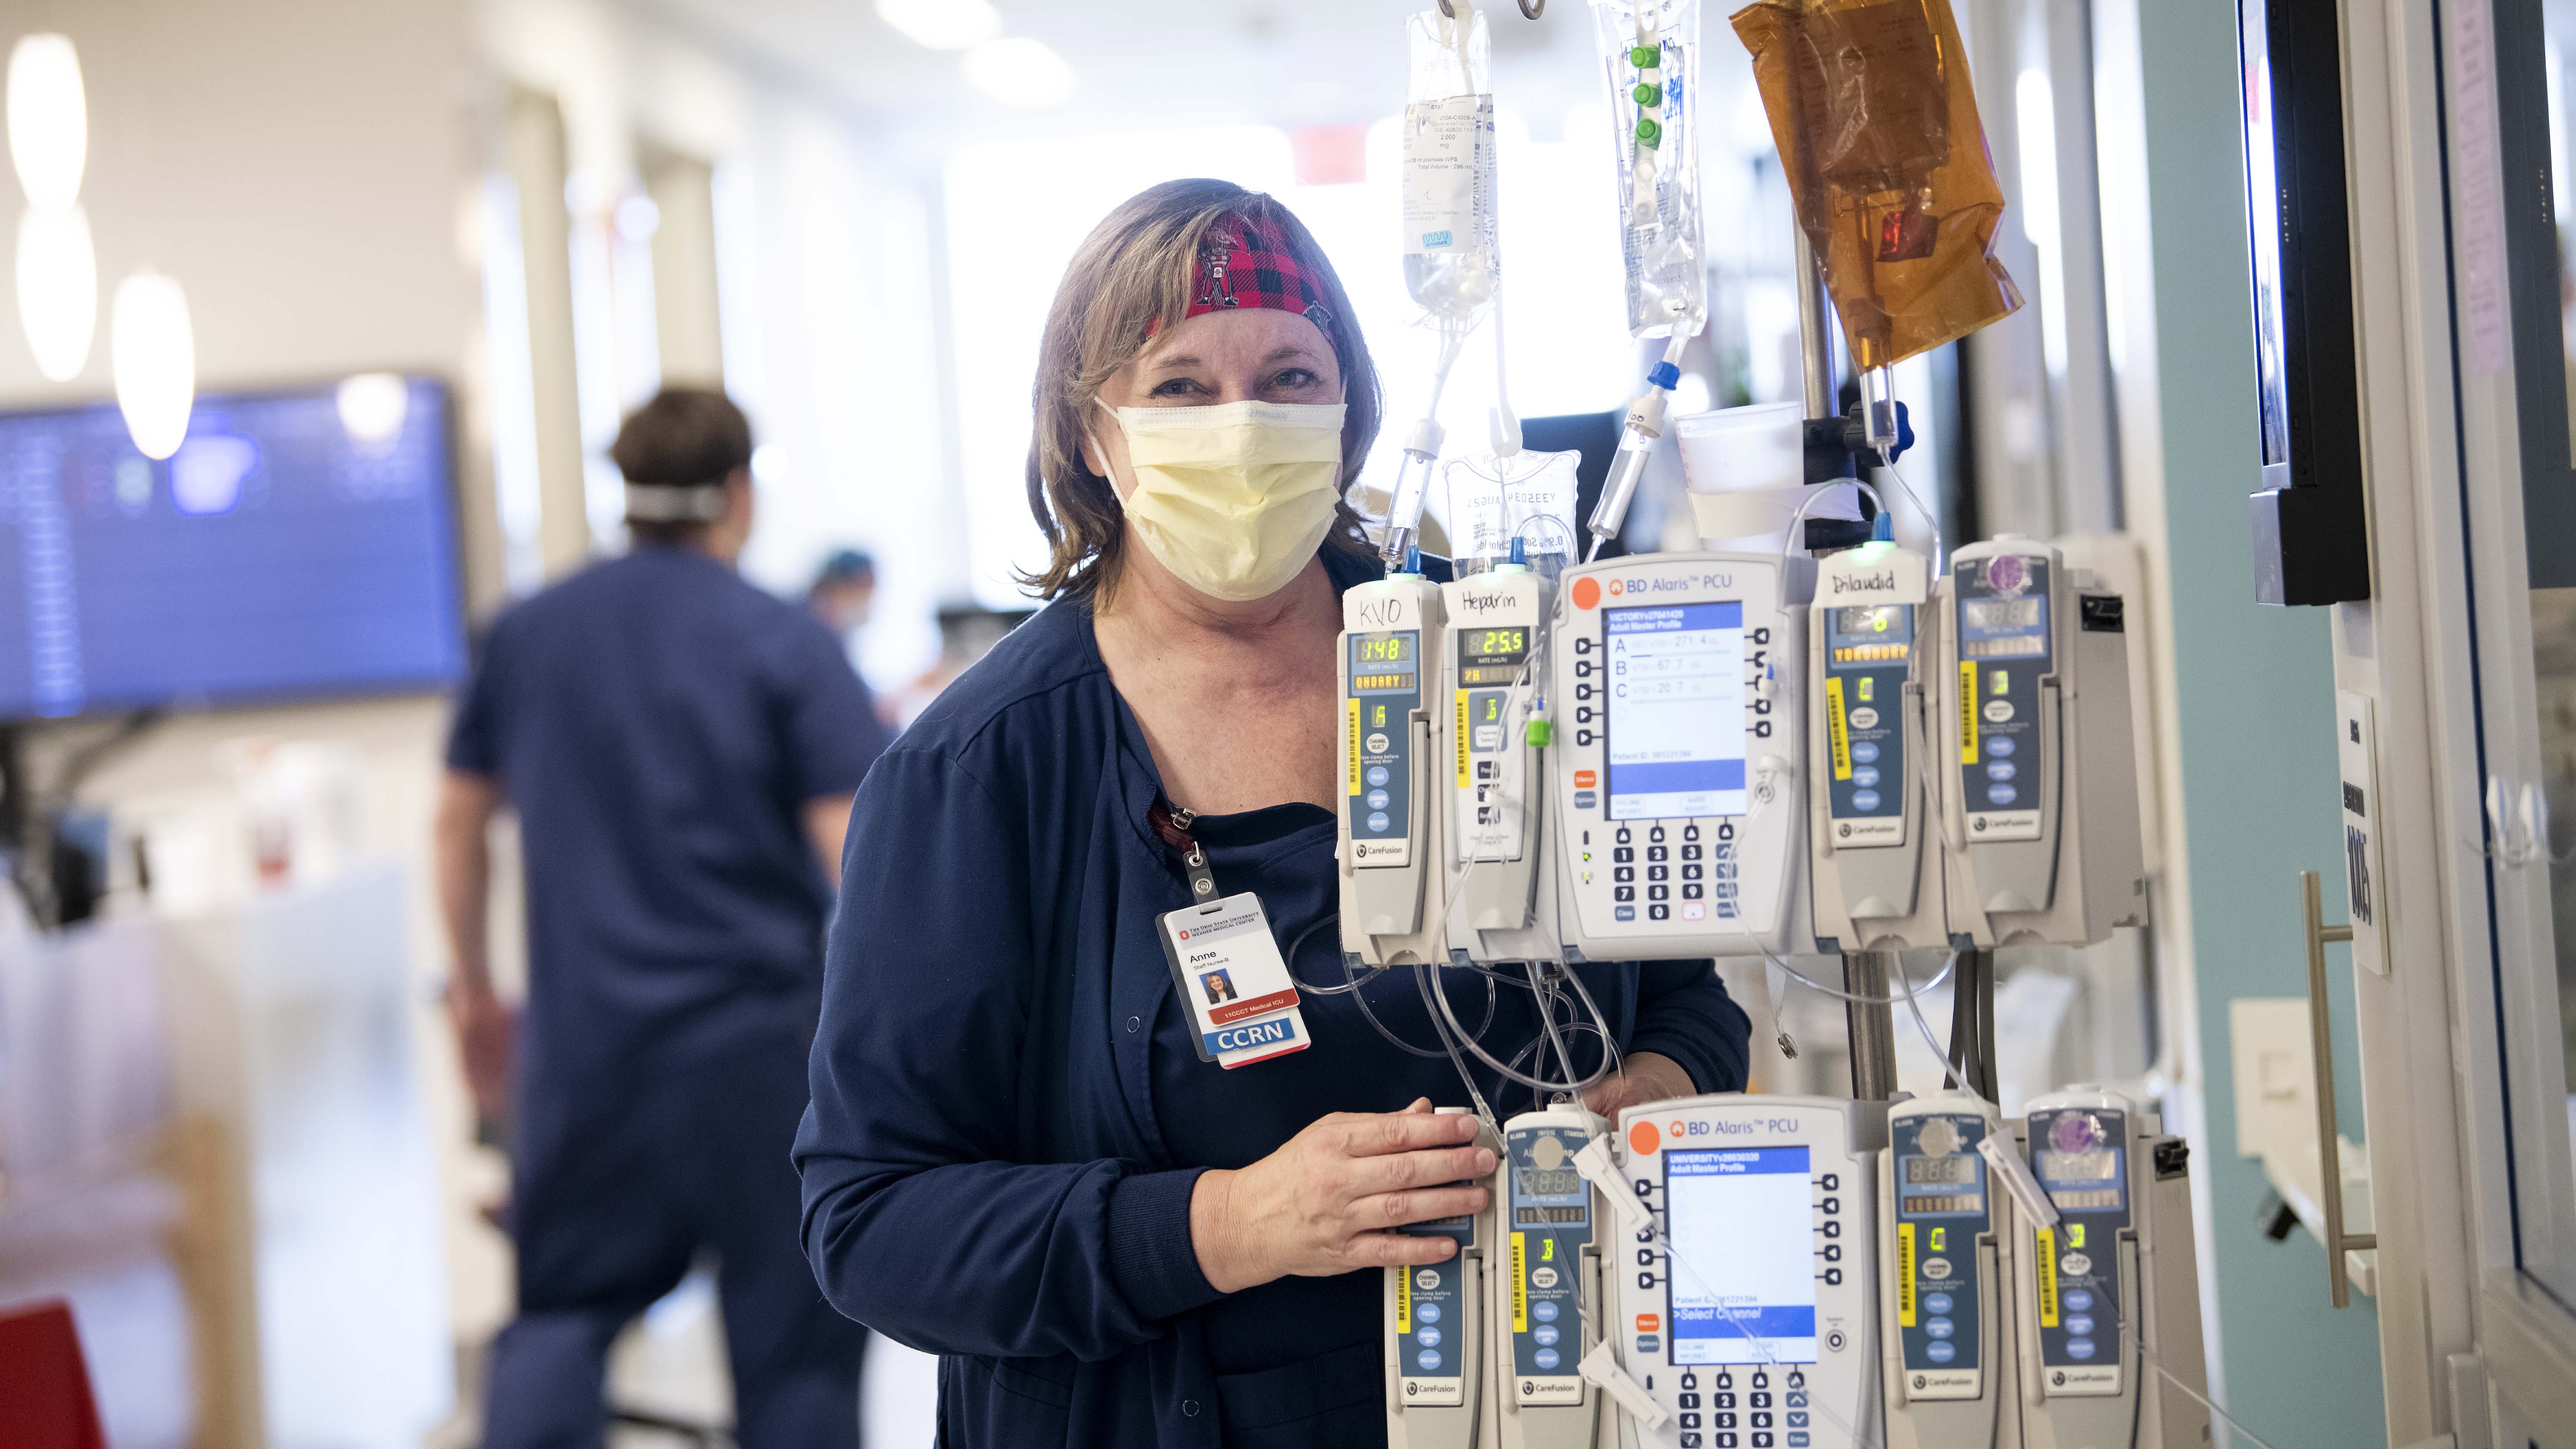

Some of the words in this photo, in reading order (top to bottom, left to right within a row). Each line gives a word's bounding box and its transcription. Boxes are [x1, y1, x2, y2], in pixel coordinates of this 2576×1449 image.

[1627, 580, 1647, 593] BD
[1703, 574, 1732, 588] PCU
[1832, 570, 1895, 593] Dilaudid
[1462, 591, 1516, 615] Heparin
[1360, 599, 1401, 626] KVO
[1366, 639, 1399, 660] 148
[1483, 631, 1522, 654] 25.5
[1615, 639, 1626, 652] A
[1616, 661, 1626, 675] B
[1356, 675, 1399, 689] ONDARY
[1859, 677, 1873, 701] C
[1616, 684, 1627, 698] C
[1376, 706, 1385, 724] A
[1621, 849, 1627, 861] 1
[1653, 848, 1662, 860] 2
[1688, 846, 1697, 859] 3
[1620, 868, 1629, 880] 4
[1655, 867, 1662, 879] 5
[1688, 866, 1697, 878] 6
[1620, 888, 1629, 900] 7
[1655, 887, 1663, 899] 8
[1688, 885, 1698, 898] 9
[1229, 912, 1259, 922] UNIVERSITY
[1654, 906, 1664, 919] 0
[1190, 951, 1216, 963] Anne
[1207, 958, 1229, 966] Nurse-B
[1225, 1008, 1248, 1018] 11CCCT
[1249, 1002, 1272, 1012] Medical
[1217, 1022, 1284, 1049] CCRN
[1689, 1122, 1709, 1135] BD
[1769, 1118, 1798, 1133] PCU
[1719, 1163, 1746, 1172] Profile
[1930, 1228, 1945, 1251] C
[1716, 1307, 1762, 1320] Cannel
[1687, 1395, 1693, 1407] 1
[1721, 1395, 1729, 1407] 2
[1756, 1394, 1766, 1407] 3
[1686, 1415, 1695, 1427] 4
[1722, 1414, 1730, 1427] 5
[1757, 1414, 1766, 1426] 6
[1722, 1434, 1731, 1447] 8
[1758, 1434, 1767, 1446] 9
